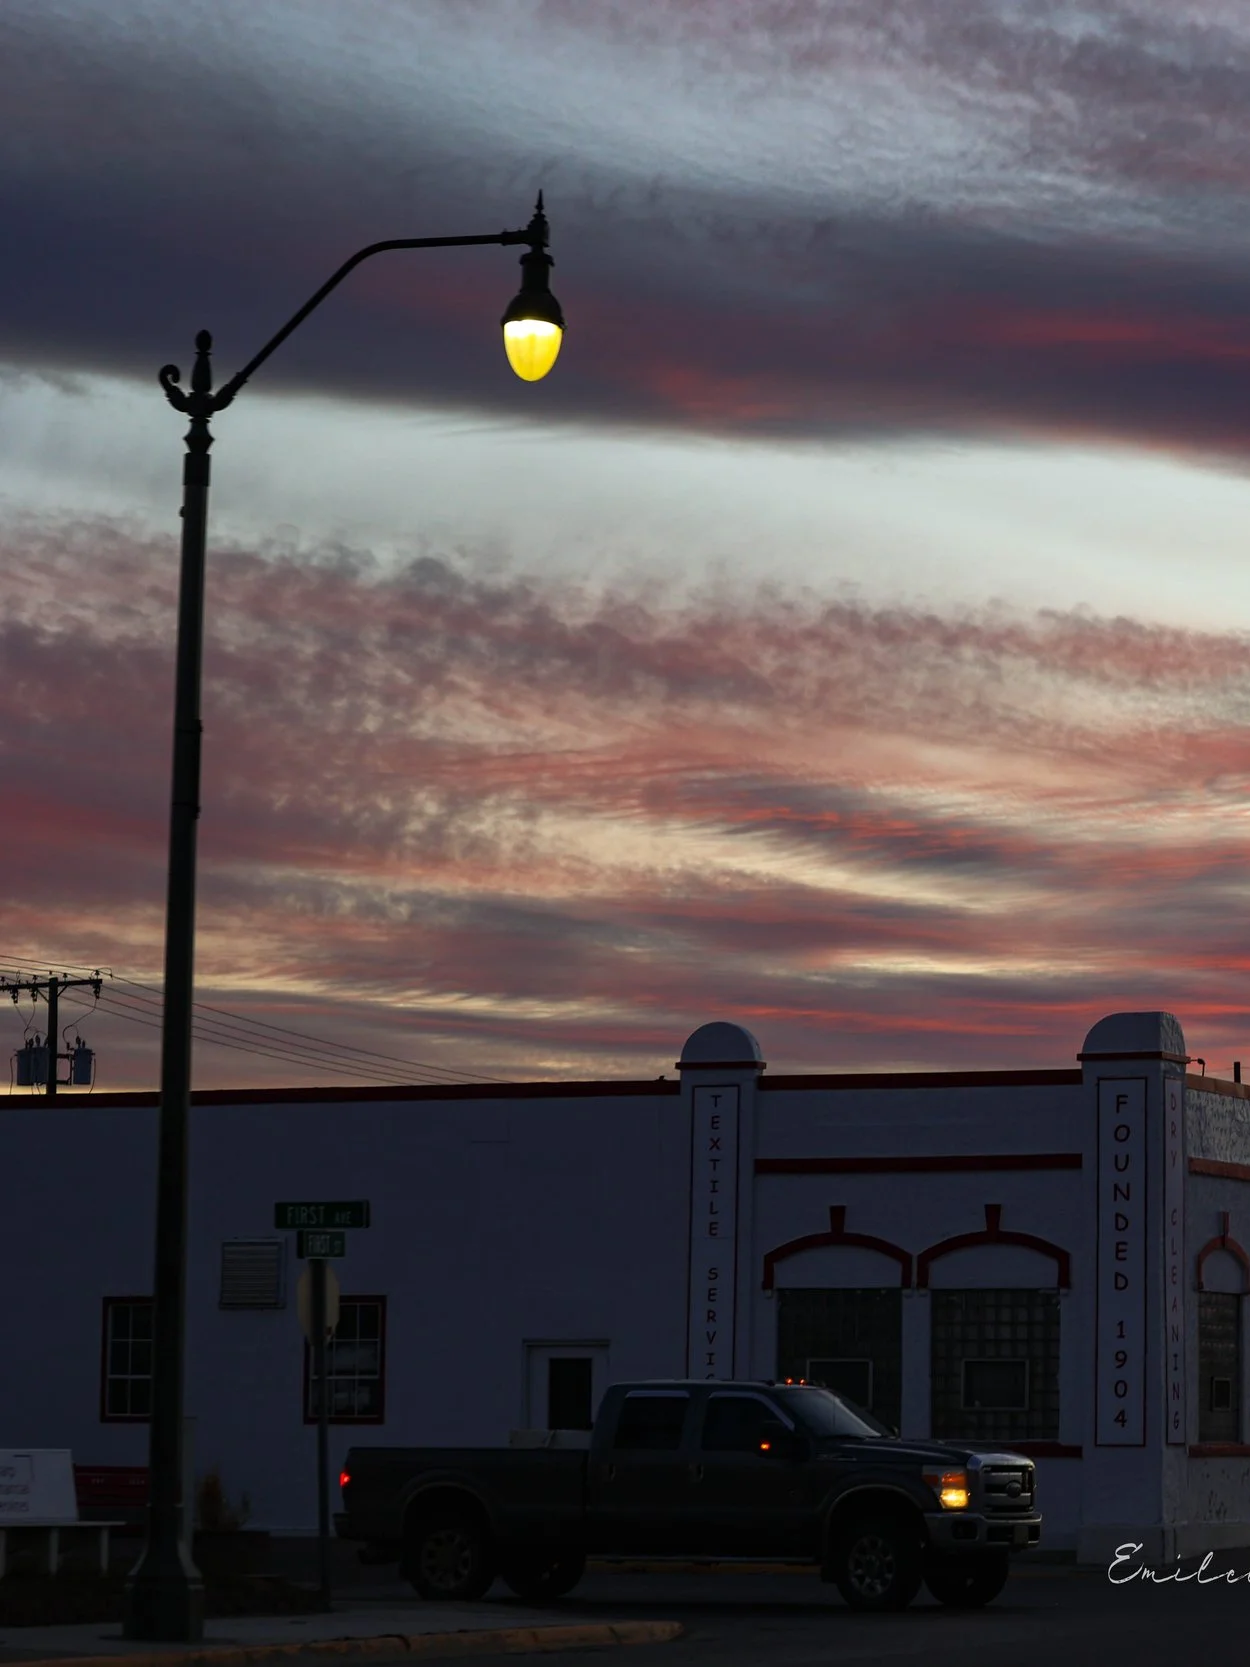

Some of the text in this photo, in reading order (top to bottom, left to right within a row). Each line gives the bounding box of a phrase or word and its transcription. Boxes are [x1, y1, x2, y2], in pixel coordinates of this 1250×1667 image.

[286, 1205, 326, 1225] FIRST
[708, 1095, 723, 1237] TEXTILE
[308, 1234, 331, 1254] FIRST
[1113, 1094, 1131, 1428] FOUNDED 1904
[1170, 1208, 1180, 1430] CLEANING
